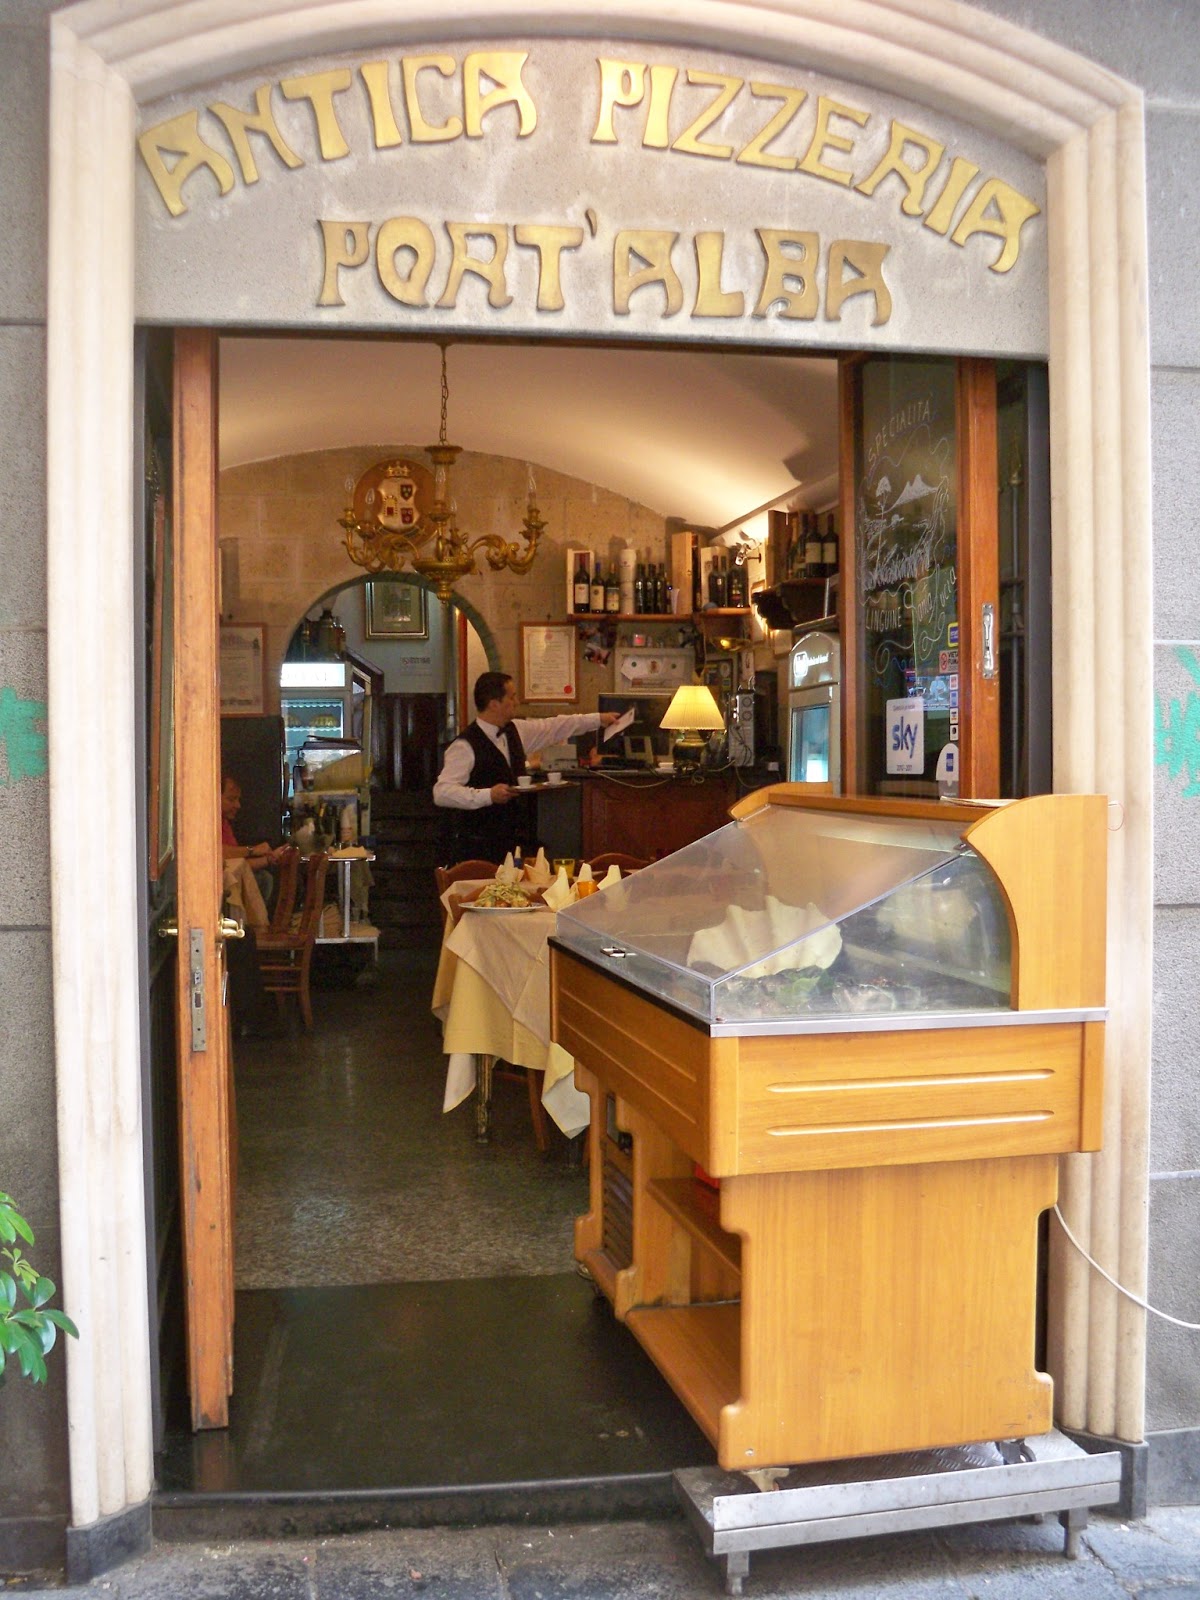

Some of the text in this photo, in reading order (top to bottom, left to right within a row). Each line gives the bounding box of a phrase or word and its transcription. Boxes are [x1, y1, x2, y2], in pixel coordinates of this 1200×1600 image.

[139, 51, 1040, 272] ANTICA PIZZERIA
[315, 207, 893, 326] PORT'ALBA
[892, 717, 918, 758] sky
